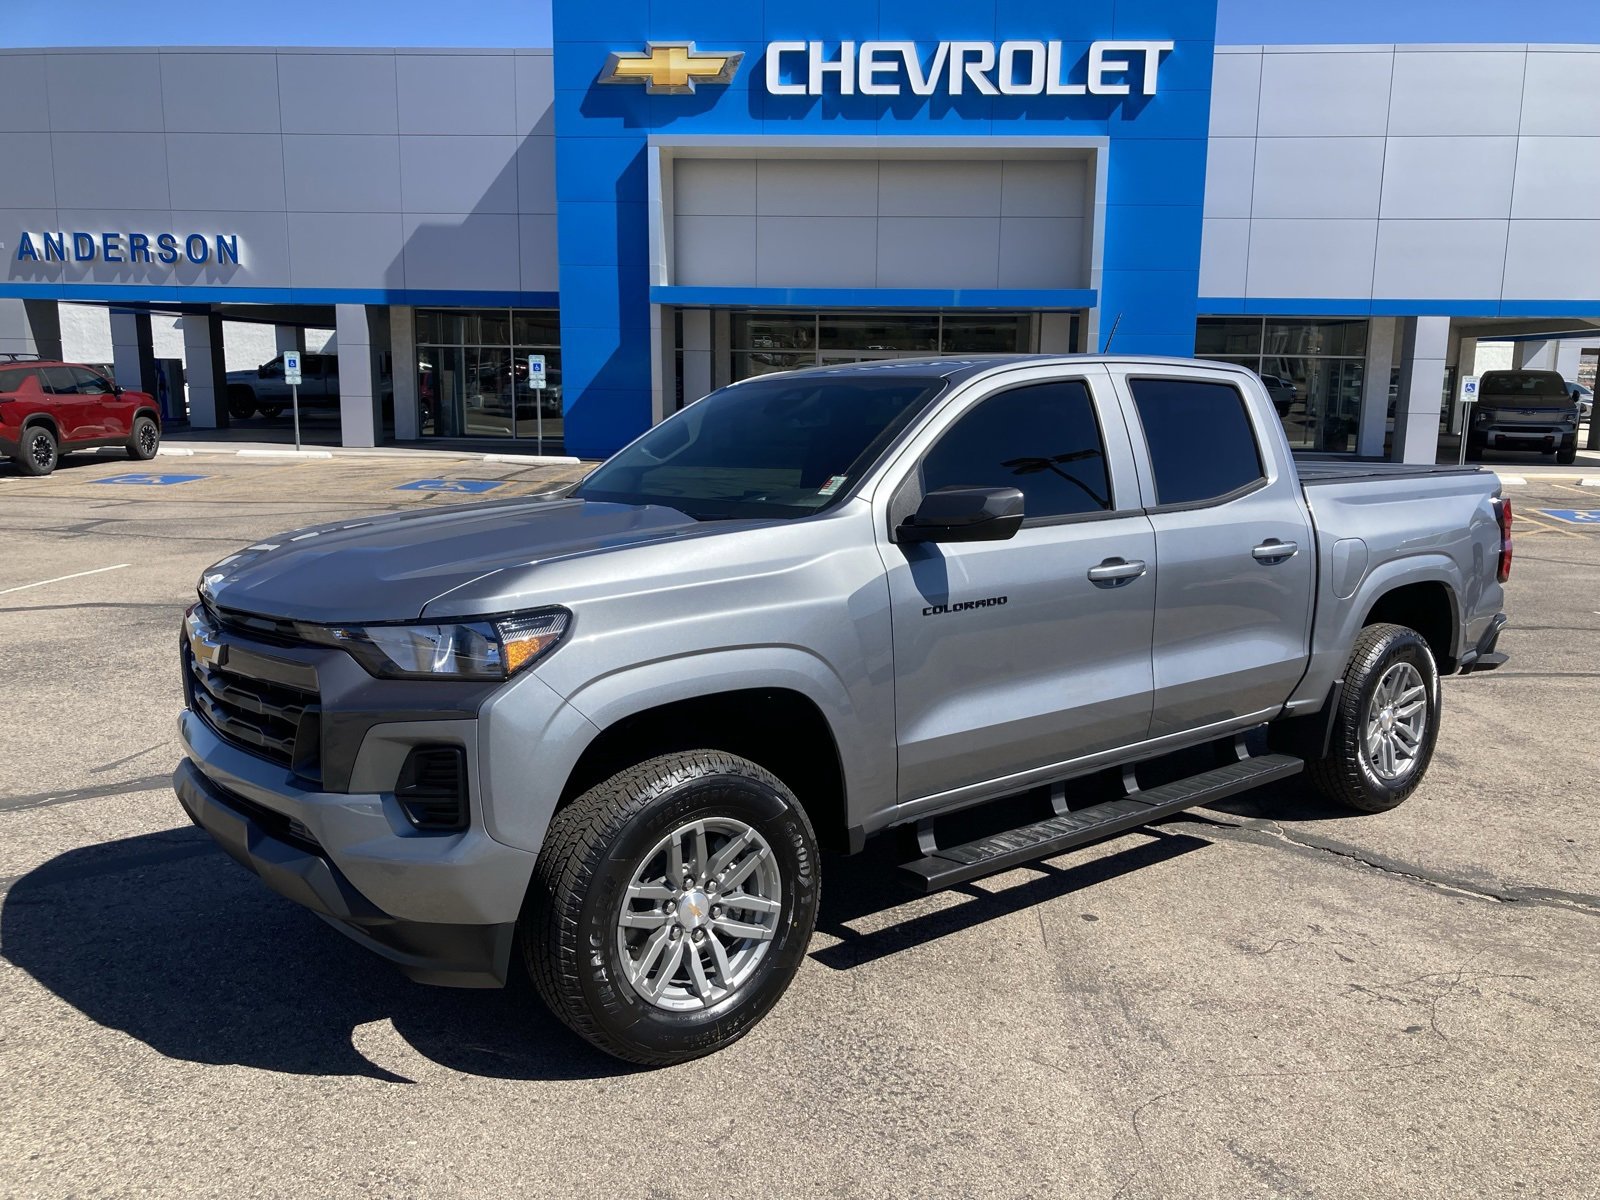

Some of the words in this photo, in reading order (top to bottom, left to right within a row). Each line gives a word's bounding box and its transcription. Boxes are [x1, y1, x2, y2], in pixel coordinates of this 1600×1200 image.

[765, 40, 1175, 95] CHEVROLET
[17, 231, 240, 265] ANDERSON
[922, 596, 1008, 617] COLORADO
